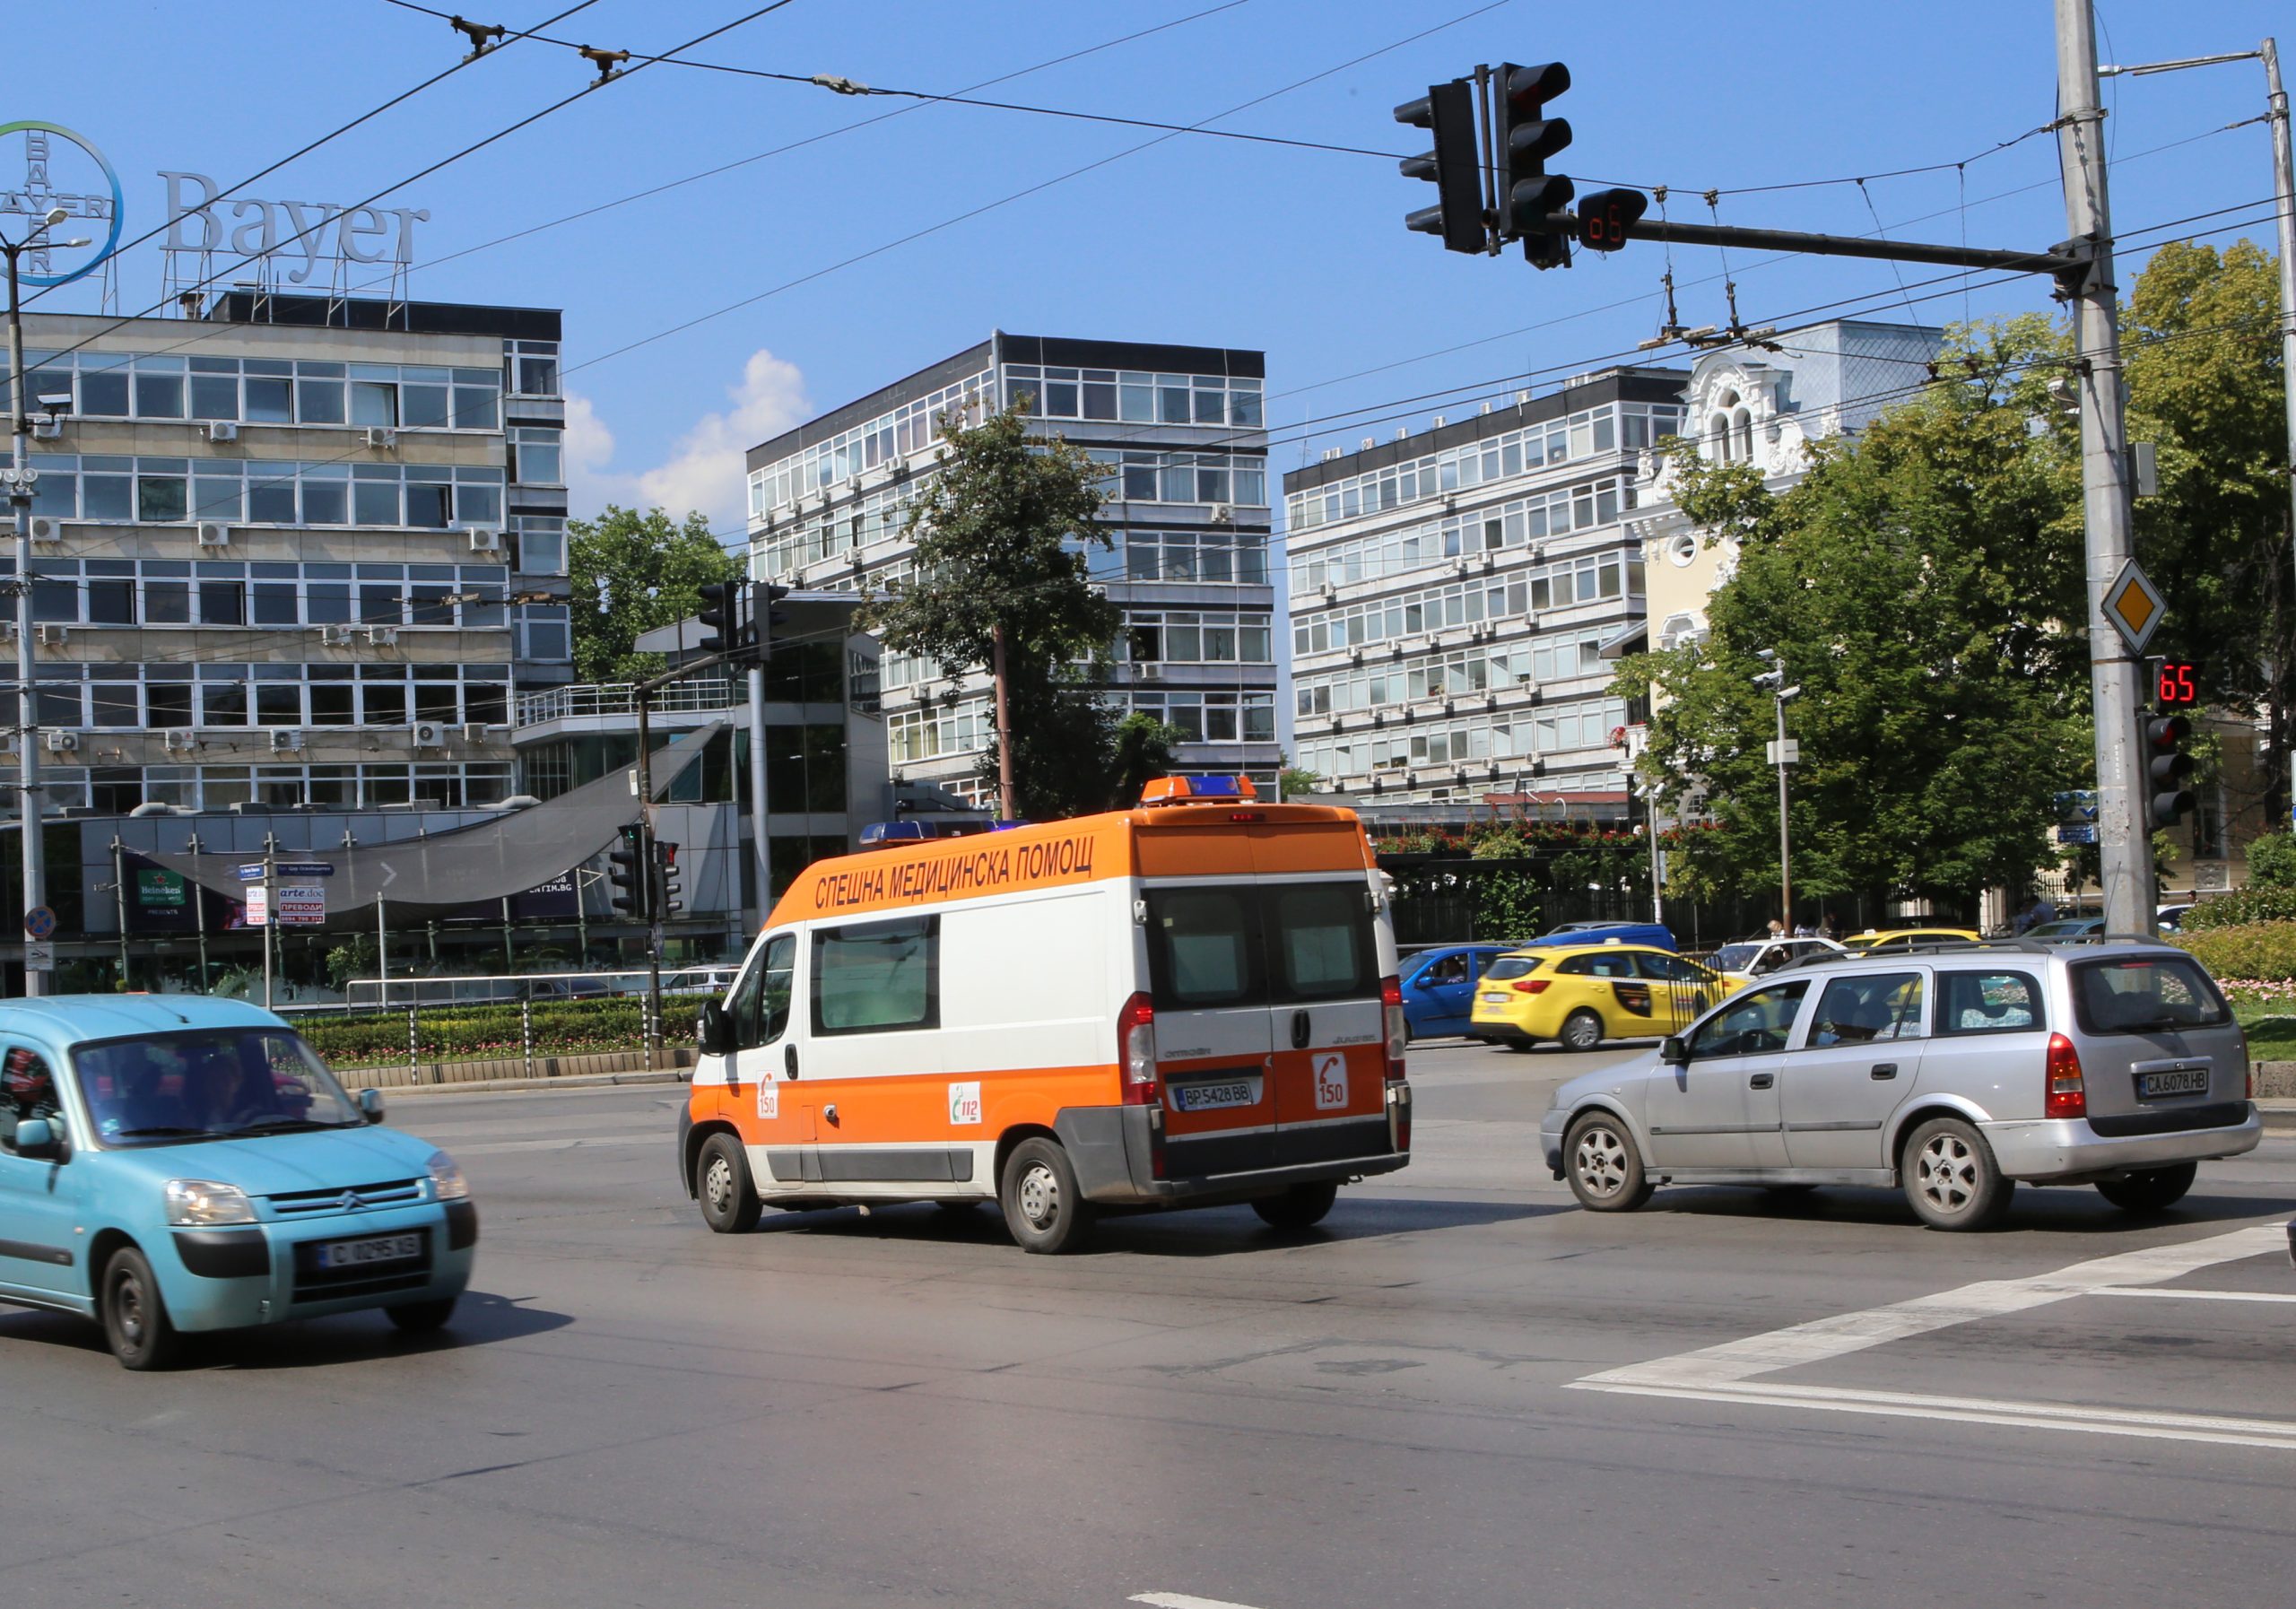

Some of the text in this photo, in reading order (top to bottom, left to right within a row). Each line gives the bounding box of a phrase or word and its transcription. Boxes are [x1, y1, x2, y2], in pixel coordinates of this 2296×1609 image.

[0, 189, 108, 219] AYER
[156, 170, 431, 284] Bayer
[2160, 665, 2194, 701] 65
[815, 835, 1094, 909] СПЕШНА МЕДИЦИНСКА ПОМОЩ
[142, 885, 181, 894] Heineken
[280, 889, 324, 898] arte.doc
[281, 903, 323, 911] ПРЕВОДИ
[1319, 1083, 1344, 1104] 150
[760, 1097, 775, 1114] 150
[961, 1100, 978, 1117] 112
